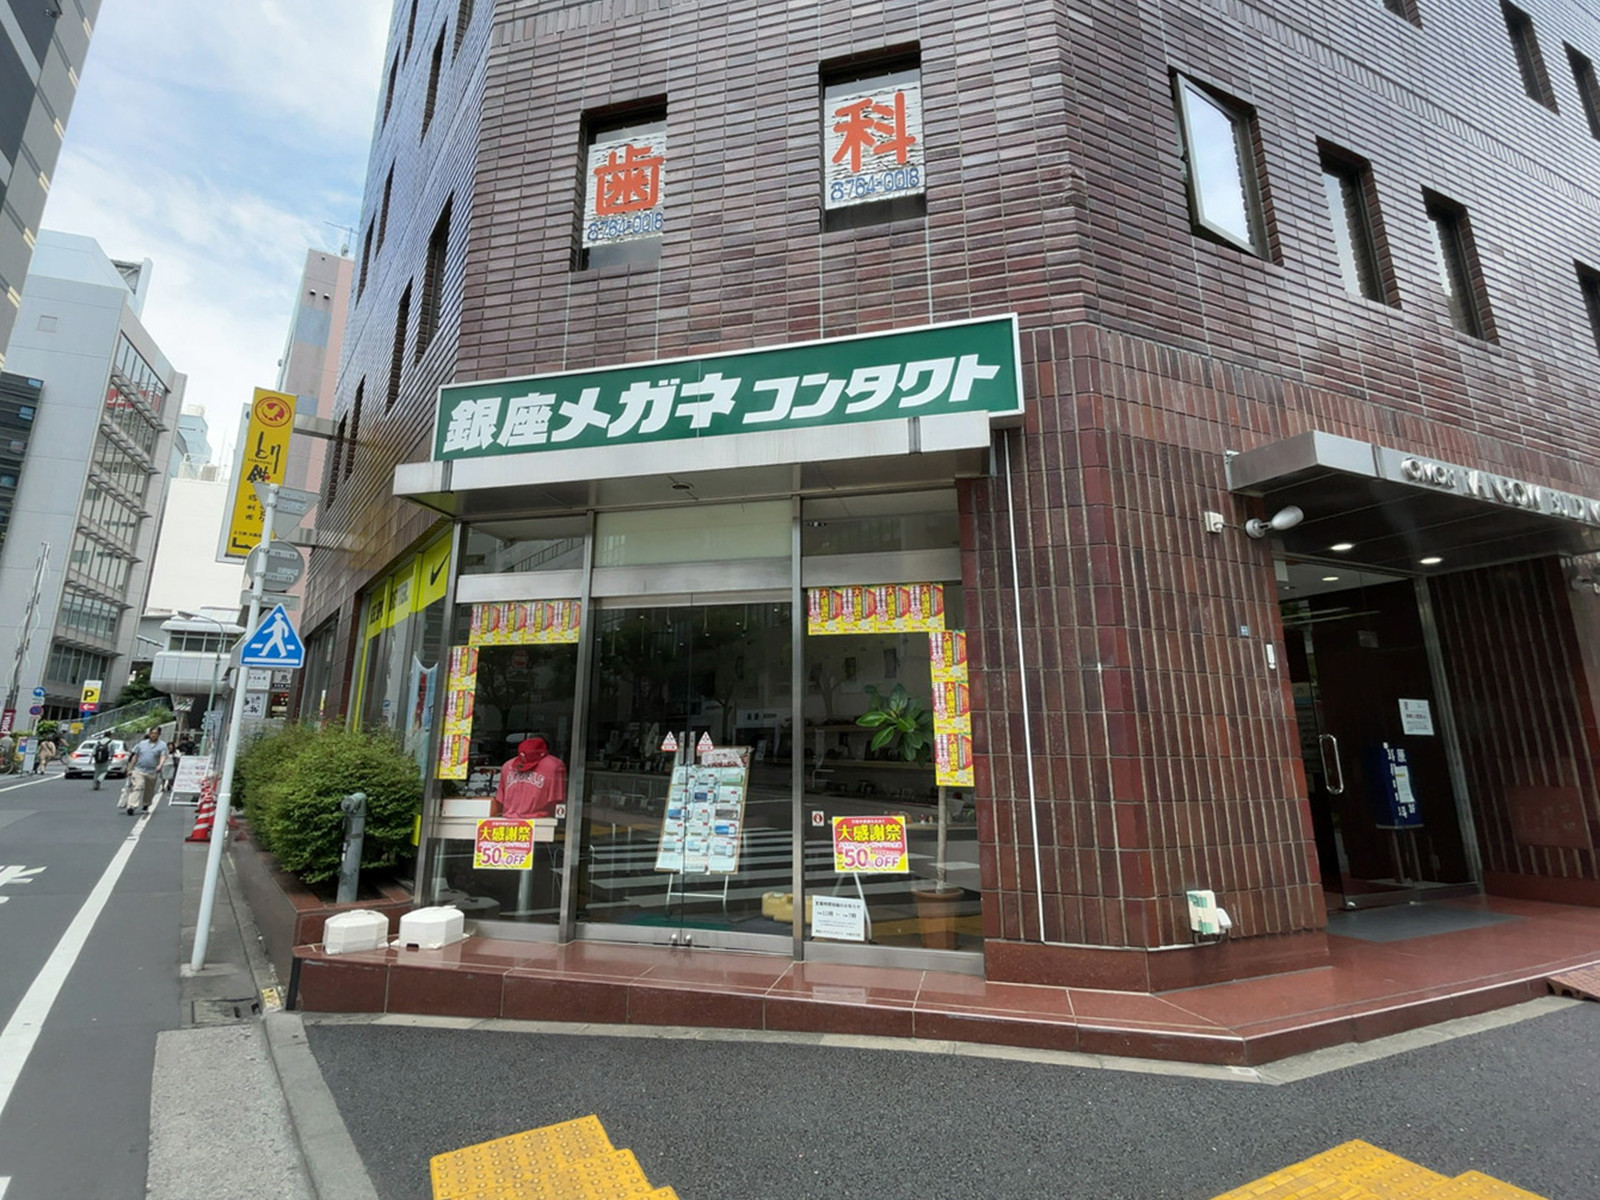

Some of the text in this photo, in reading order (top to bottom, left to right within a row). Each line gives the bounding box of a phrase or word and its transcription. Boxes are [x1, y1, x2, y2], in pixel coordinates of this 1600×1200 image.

[832, 91, 917, 173] 科
[594, 144, 665, 216] 歯
[442, 352, 1001, 453] 銀座メガネコンタクト
[84, 690, 95, 701] P
[479, 825, 531, 842] 大感謝祭
[837, 824, 902, 842] 大感謝祭
